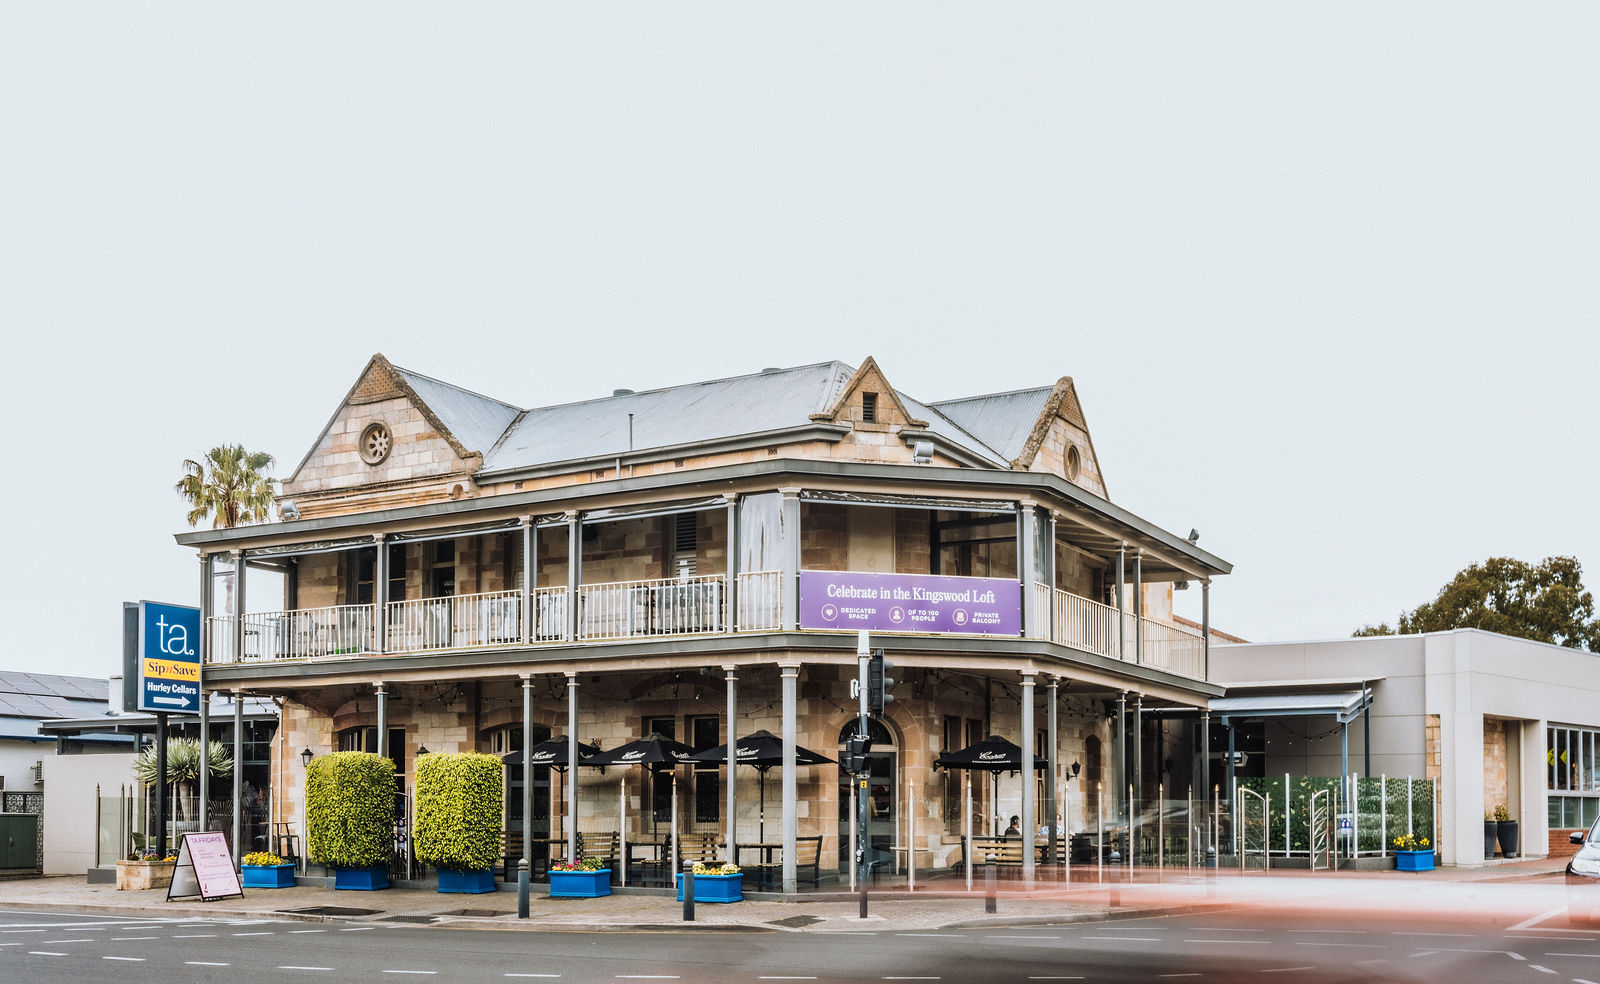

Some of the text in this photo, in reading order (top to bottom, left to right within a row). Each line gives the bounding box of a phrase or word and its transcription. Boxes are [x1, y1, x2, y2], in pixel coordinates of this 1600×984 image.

[827, 584, 996, 604] Celebrate in the Kingswood Loft
[147, 681, 197, 695] Hurley Cellars
